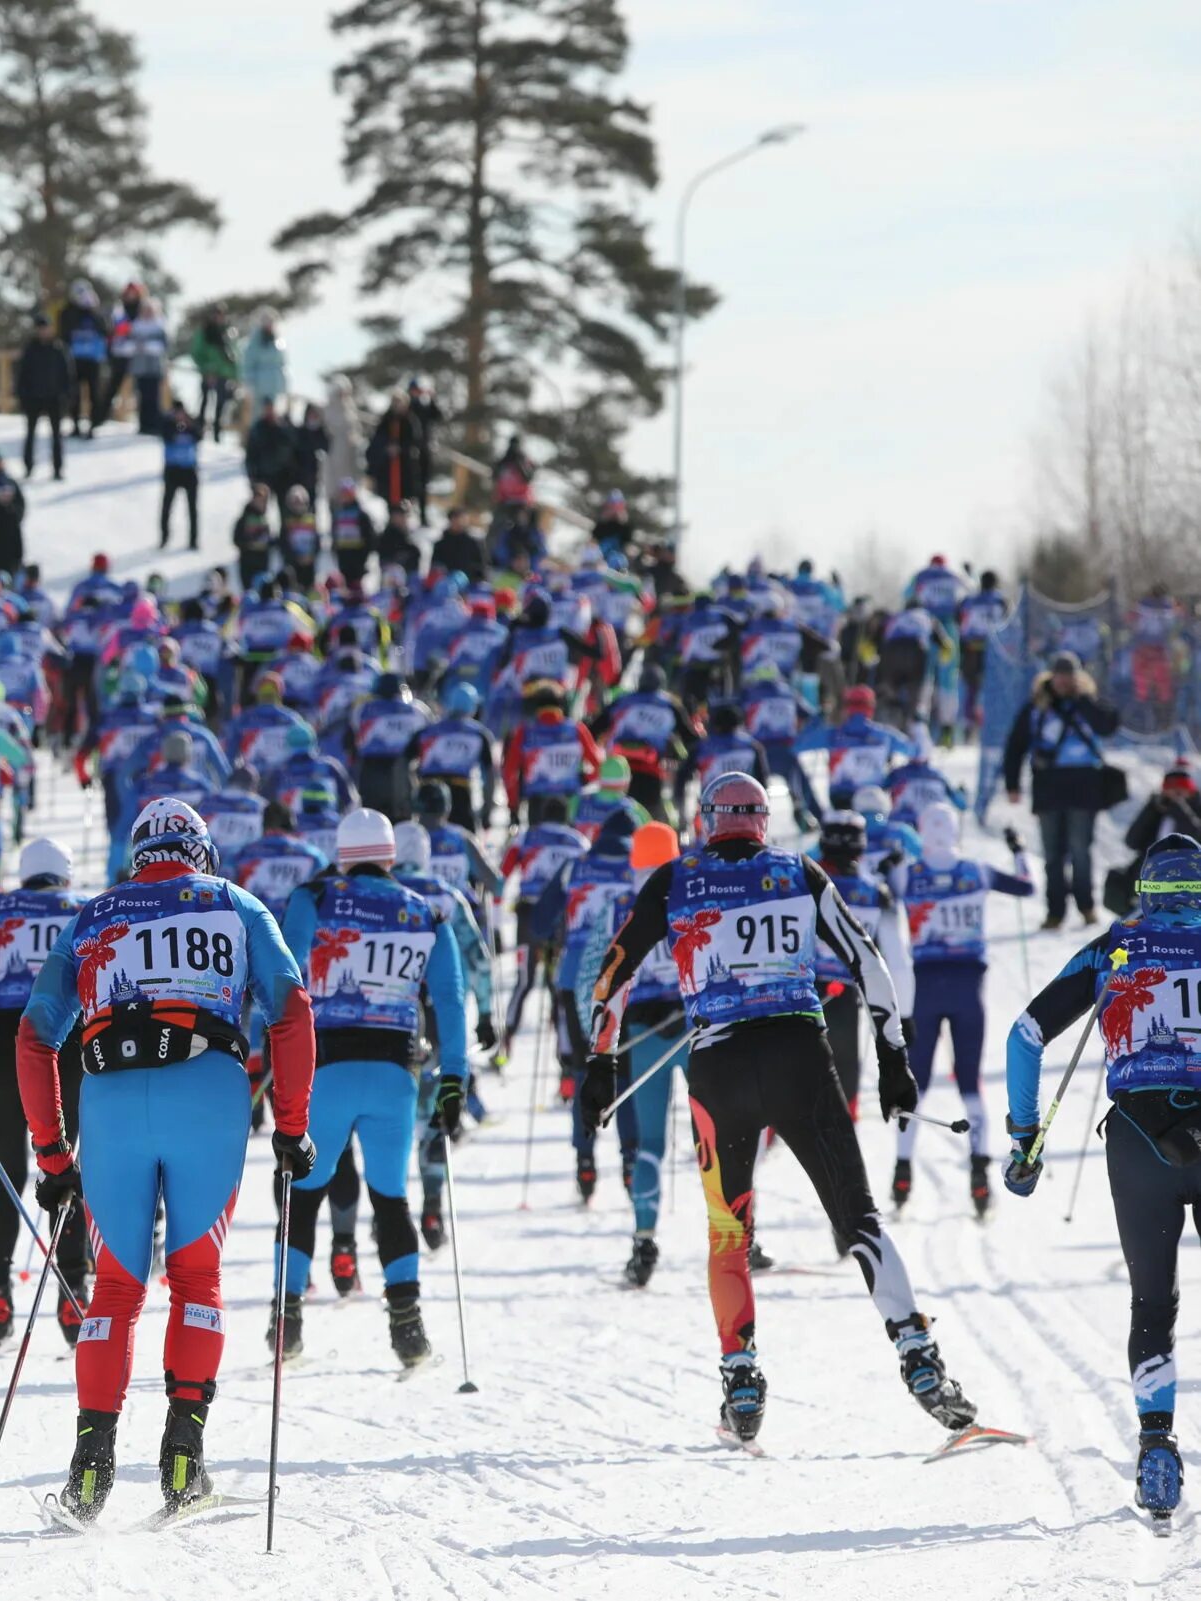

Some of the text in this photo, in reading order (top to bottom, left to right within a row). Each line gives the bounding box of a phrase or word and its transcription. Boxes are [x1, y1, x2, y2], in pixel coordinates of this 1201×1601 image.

[117, 899, 161, 909] Rostec
[709, 884, 746, 893] Rostec
[736, 914, 800, 955] 915
[1152, 945, 1195, 955] Rostec
[135, 927, 234, 977] 1188
[364, 939, 427, 982] 1123
[92, 1038, 105, 1070] COXA
[158, 1028, 171, 1059] COXA
[1143, 1061, 1178, 1072] RYBINSK
